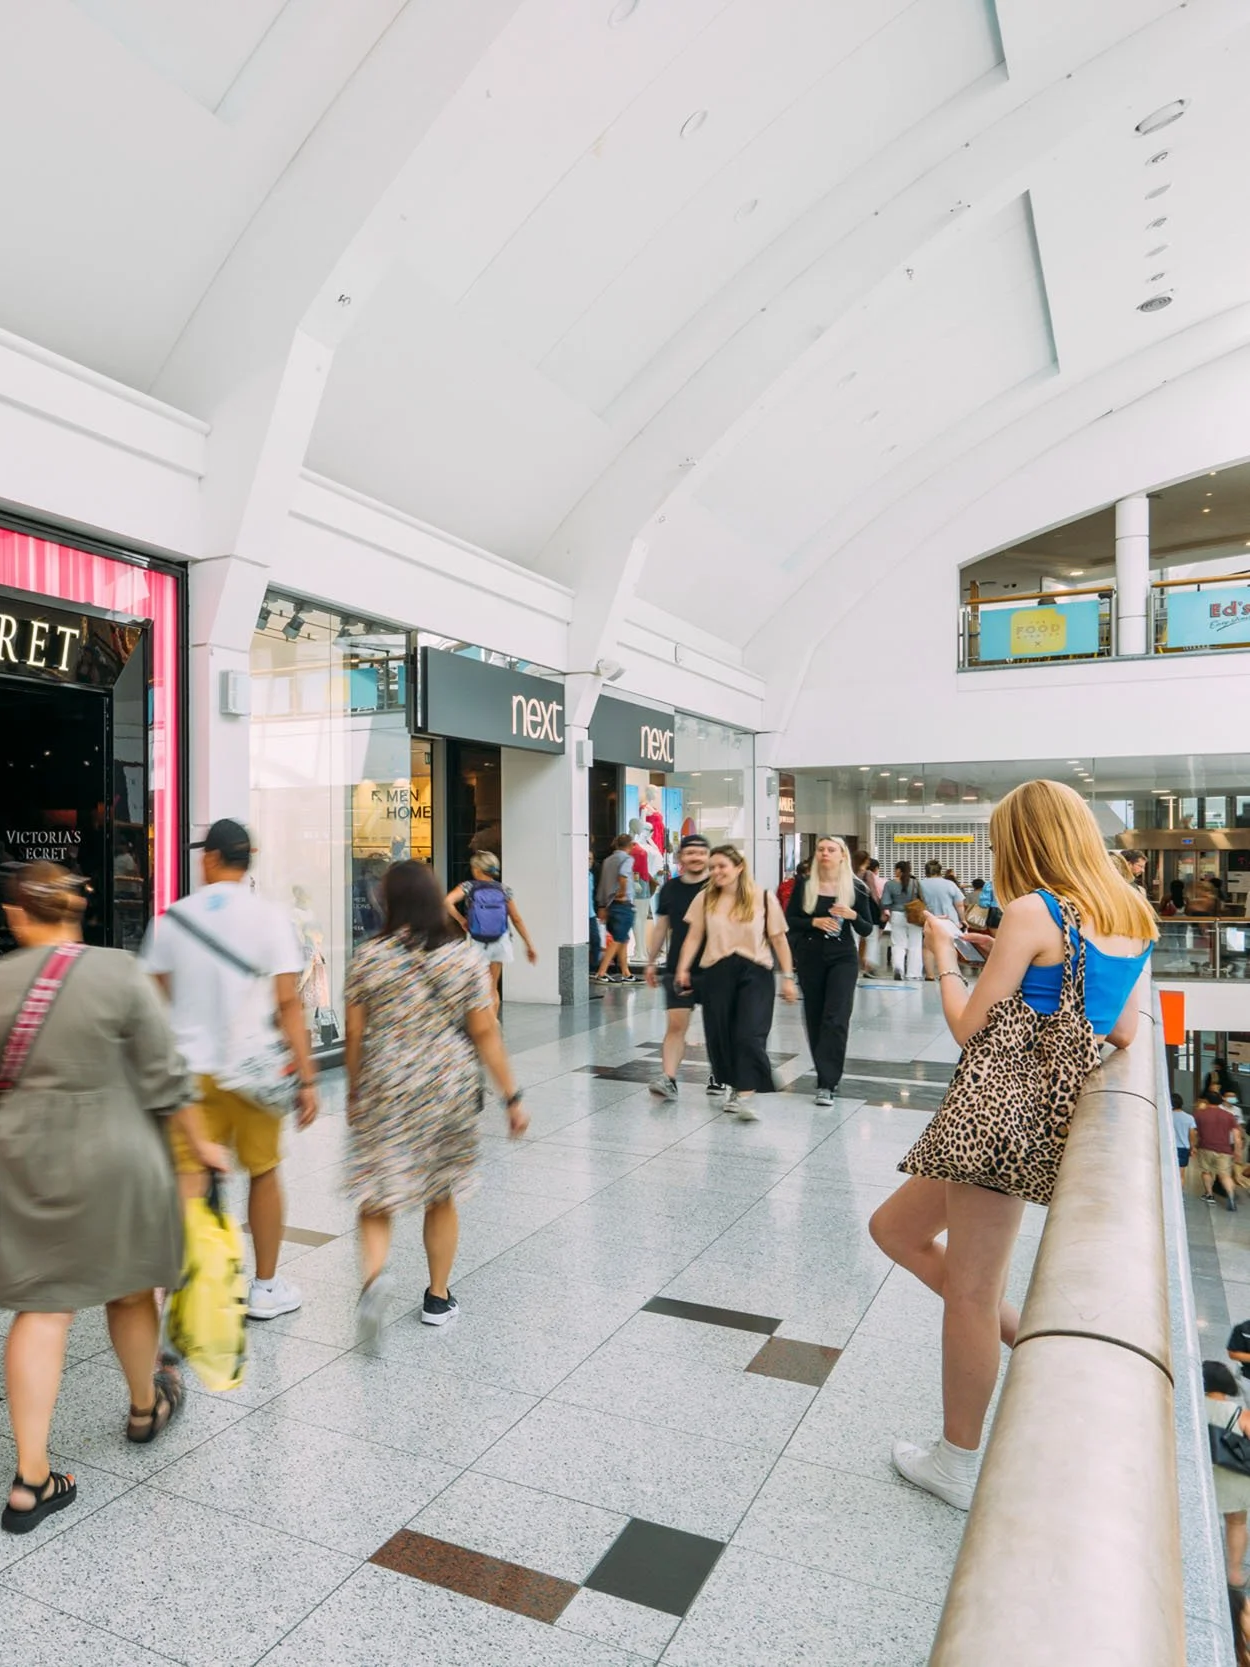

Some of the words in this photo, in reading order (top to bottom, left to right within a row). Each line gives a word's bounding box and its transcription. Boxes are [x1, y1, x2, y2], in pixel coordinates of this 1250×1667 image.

[1209, 600, 1250, 618] Ed's
[1016, 623, 1060, 636] FOOD
[511, 693, 564, 744] next
[640, 724, 674, 764] next
[386, 788, 419, 803] MEN
[386, 805, 432, 820] HOME
[6, 829, 82, 844] VICTORIA'S
